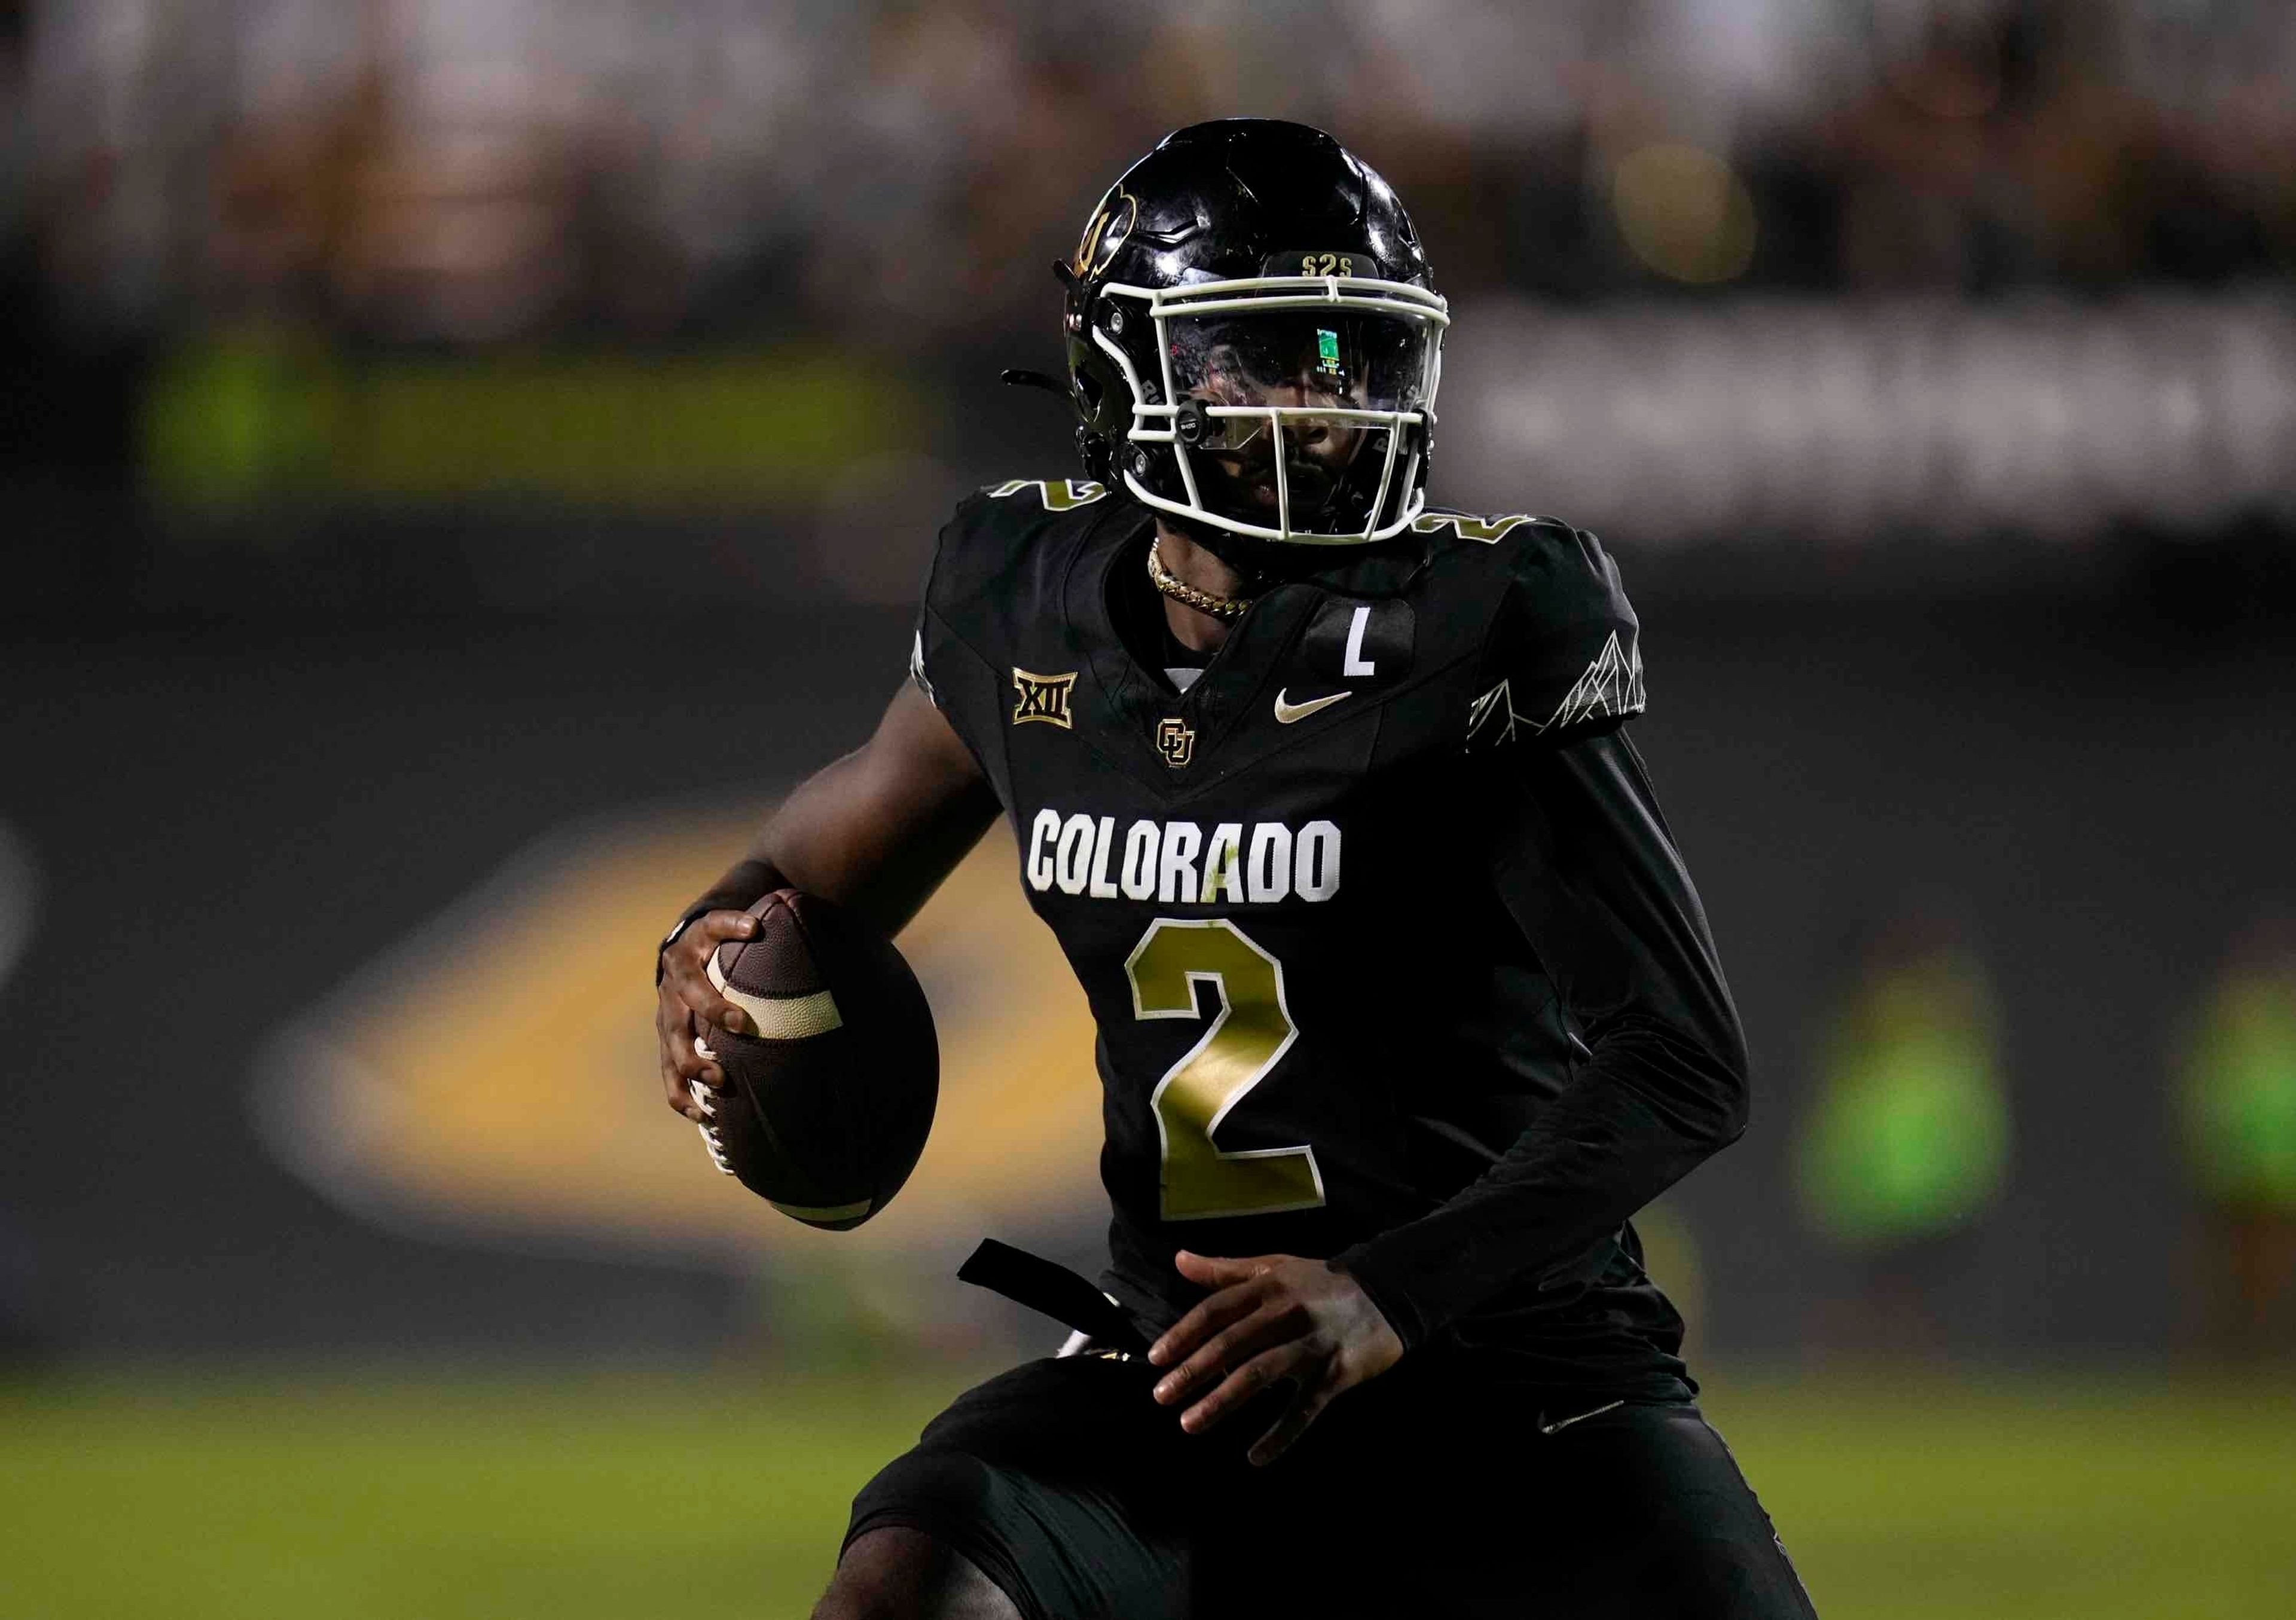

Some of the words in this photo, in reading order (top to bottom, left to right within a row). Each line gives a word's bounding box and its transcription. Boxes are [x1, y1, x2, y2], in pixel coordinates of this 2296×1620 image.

[1302, 254, 1352, 277] S2S
[1344, 606, 1375, 676] L
[1015, 673, 1074, 725] XII
[1027, 809, 1342, 904] COLORADO
[1124, 918, 1326, 1221] 2
